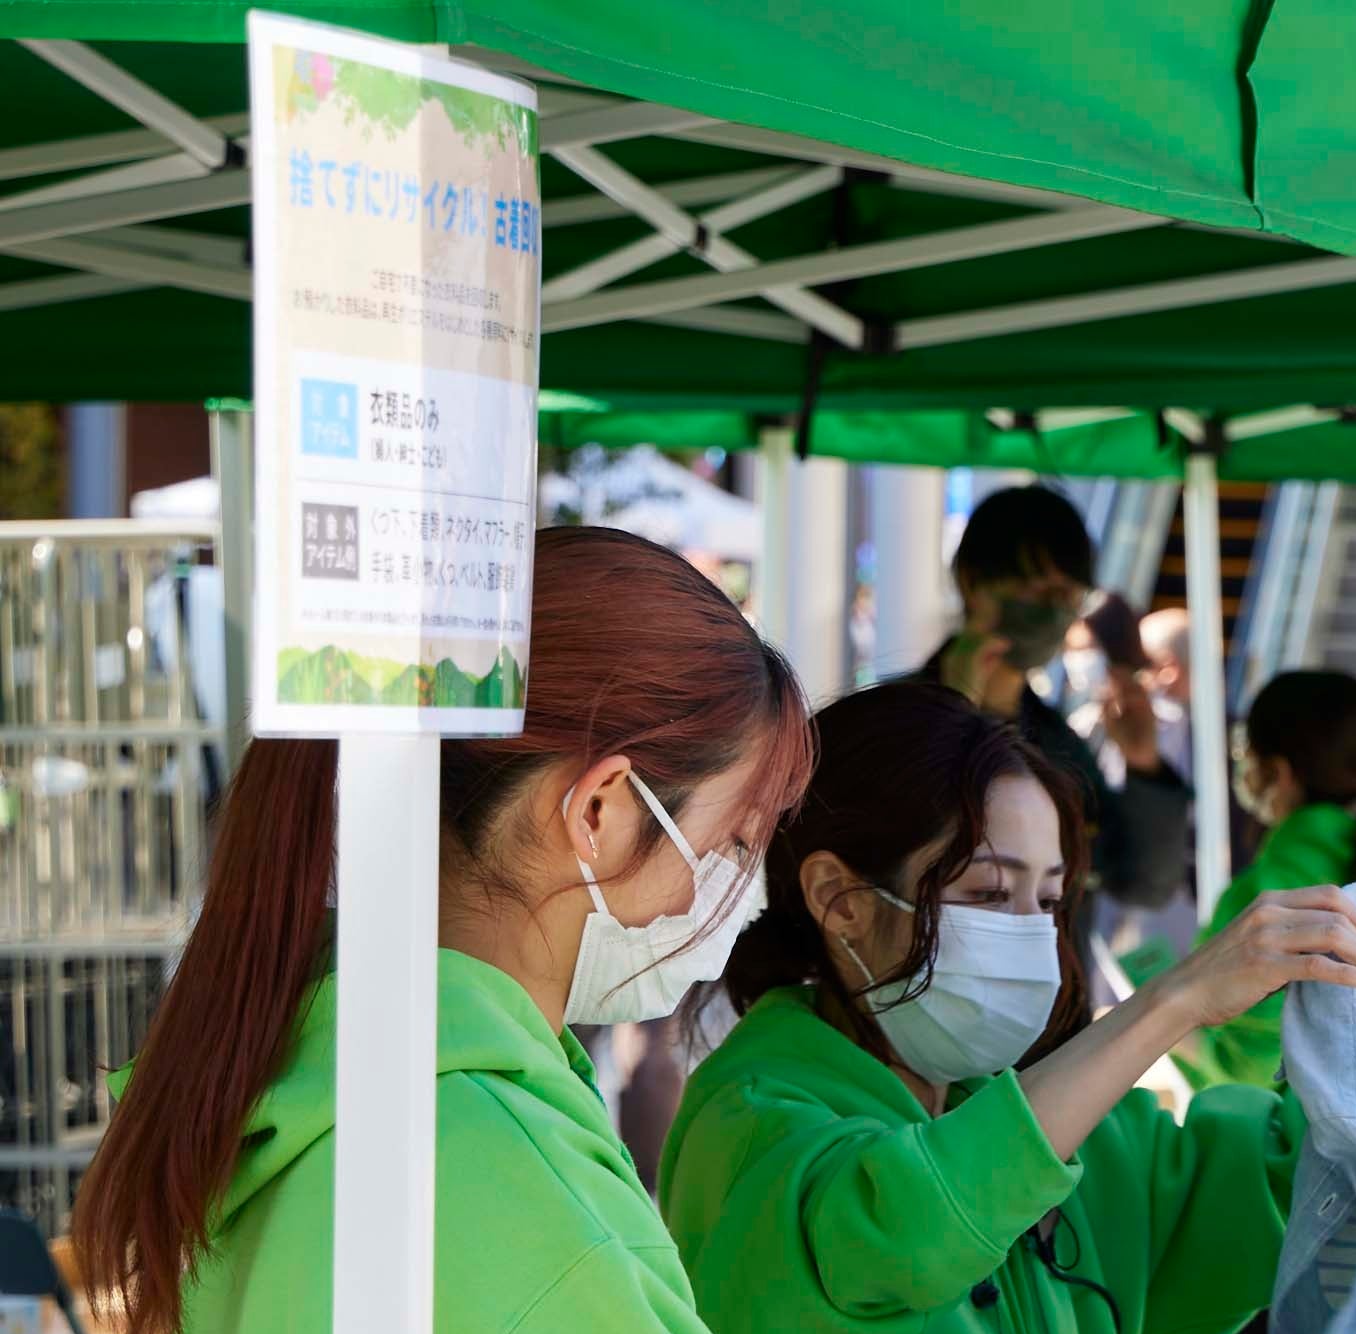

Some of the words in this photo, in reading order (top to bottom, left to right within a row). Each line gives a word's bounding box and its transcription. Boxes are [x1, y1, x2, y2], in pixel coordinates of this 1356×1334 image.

[370, 387, 440, 432] 衣類品のみ
